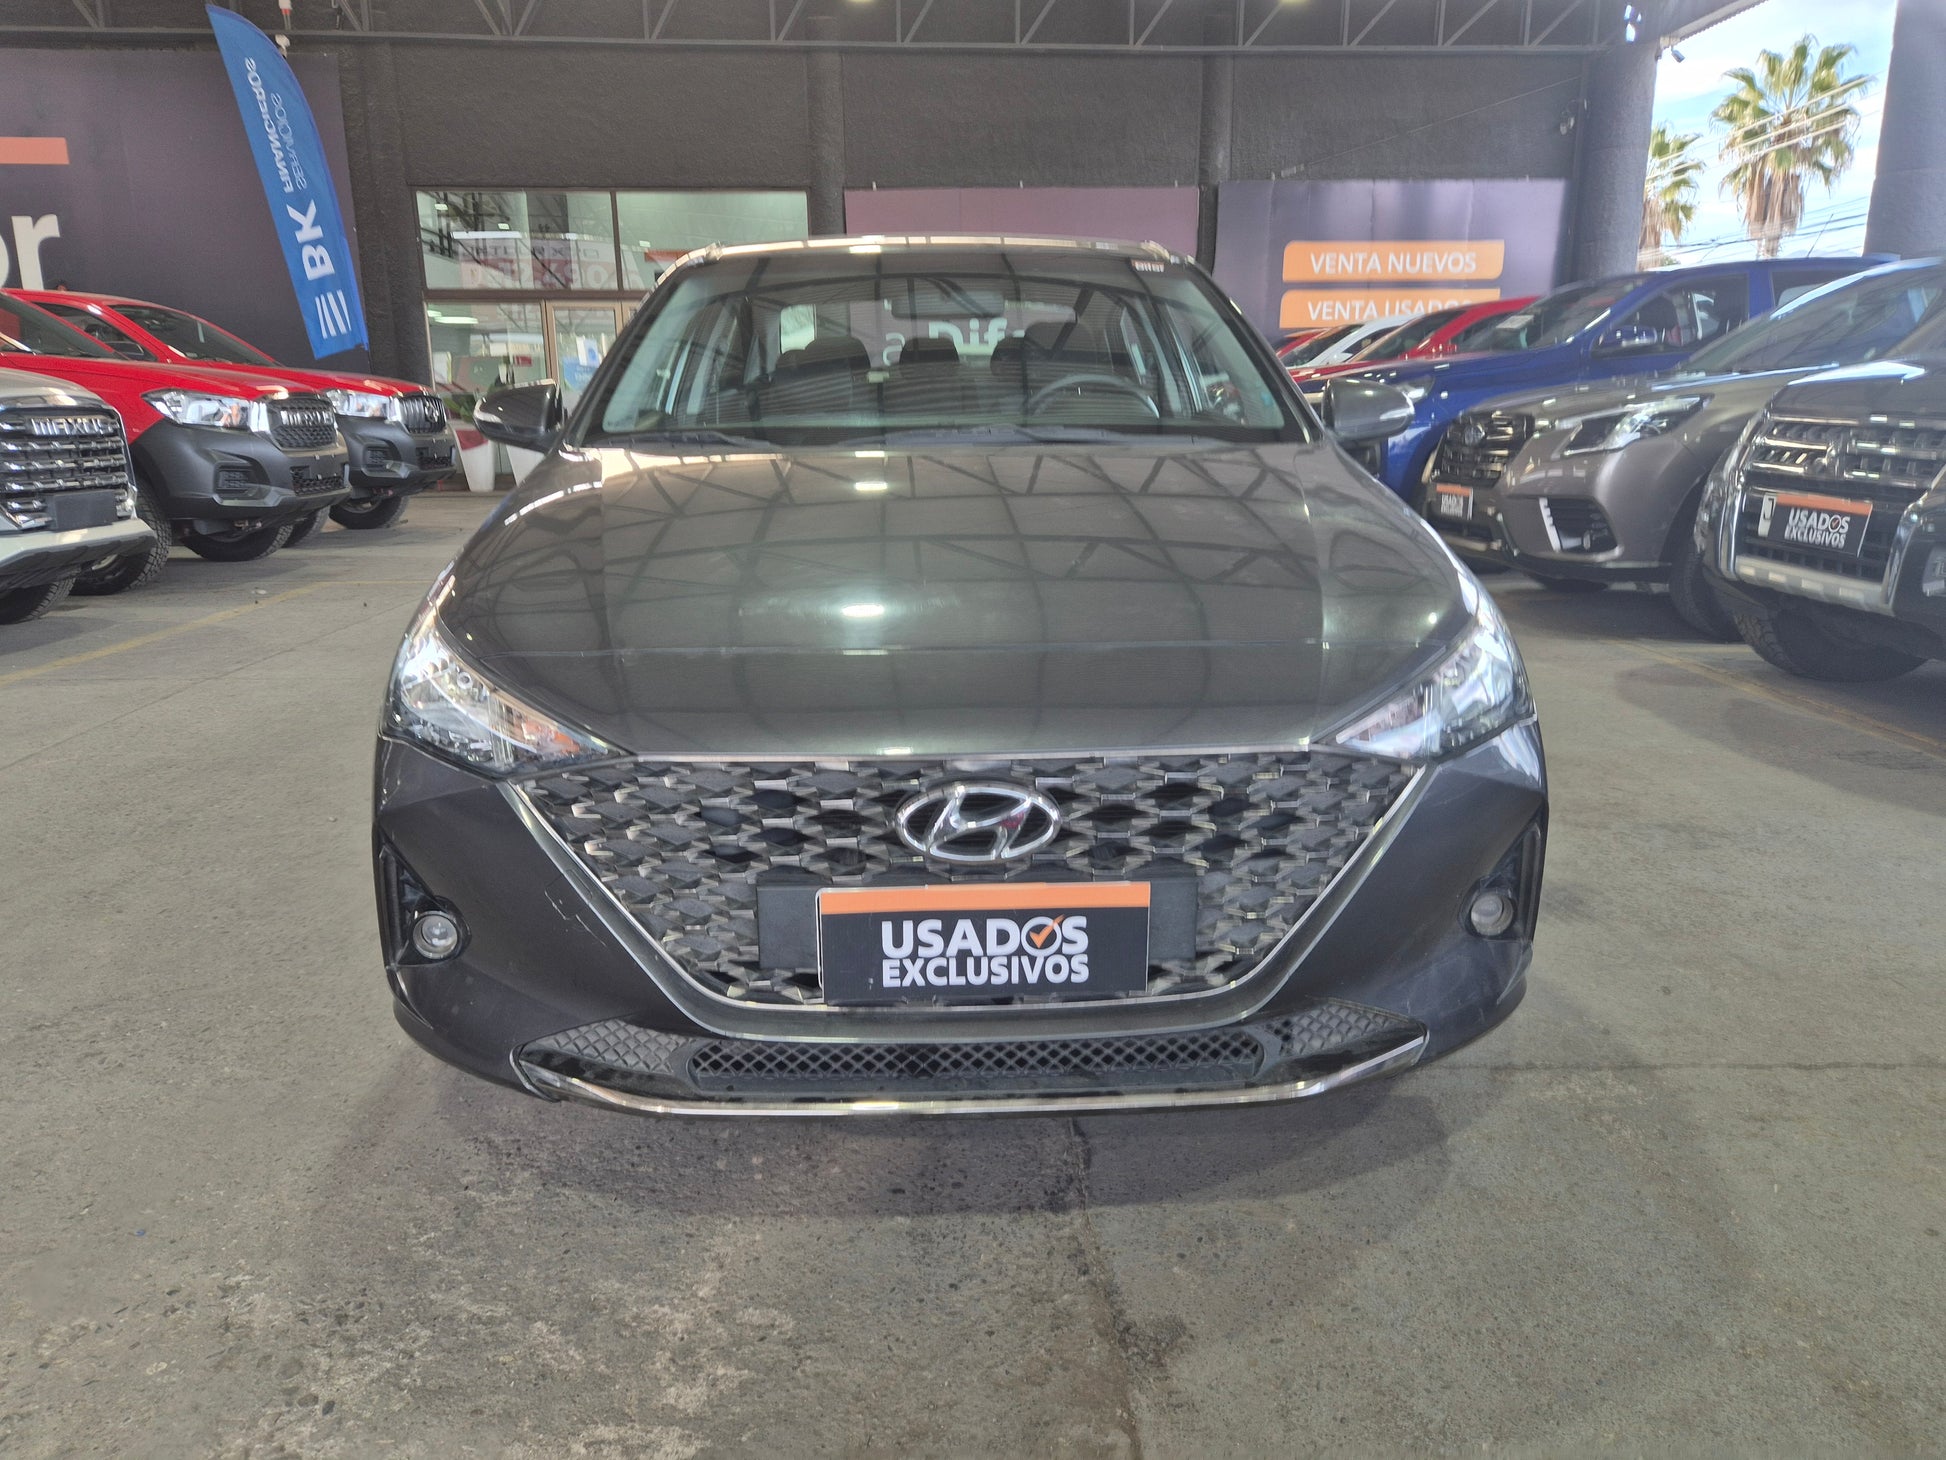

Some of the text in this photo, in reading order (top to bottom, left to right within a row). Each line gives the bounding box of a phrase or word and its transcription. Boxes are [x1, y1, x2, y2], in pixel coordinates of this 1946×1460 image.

[1310, 251, 1477, 274] VENTA NUEVOS
[1307, 300, 1378, 321] VENTA
[1788, 507, 1850, 534] USADOS
[1784, 523, 1846, 548] EXCLUSIVOS
[881, 915, 1089, 958] USADOS
[882, 954, 1089, 987] EXCLUSIVOS
